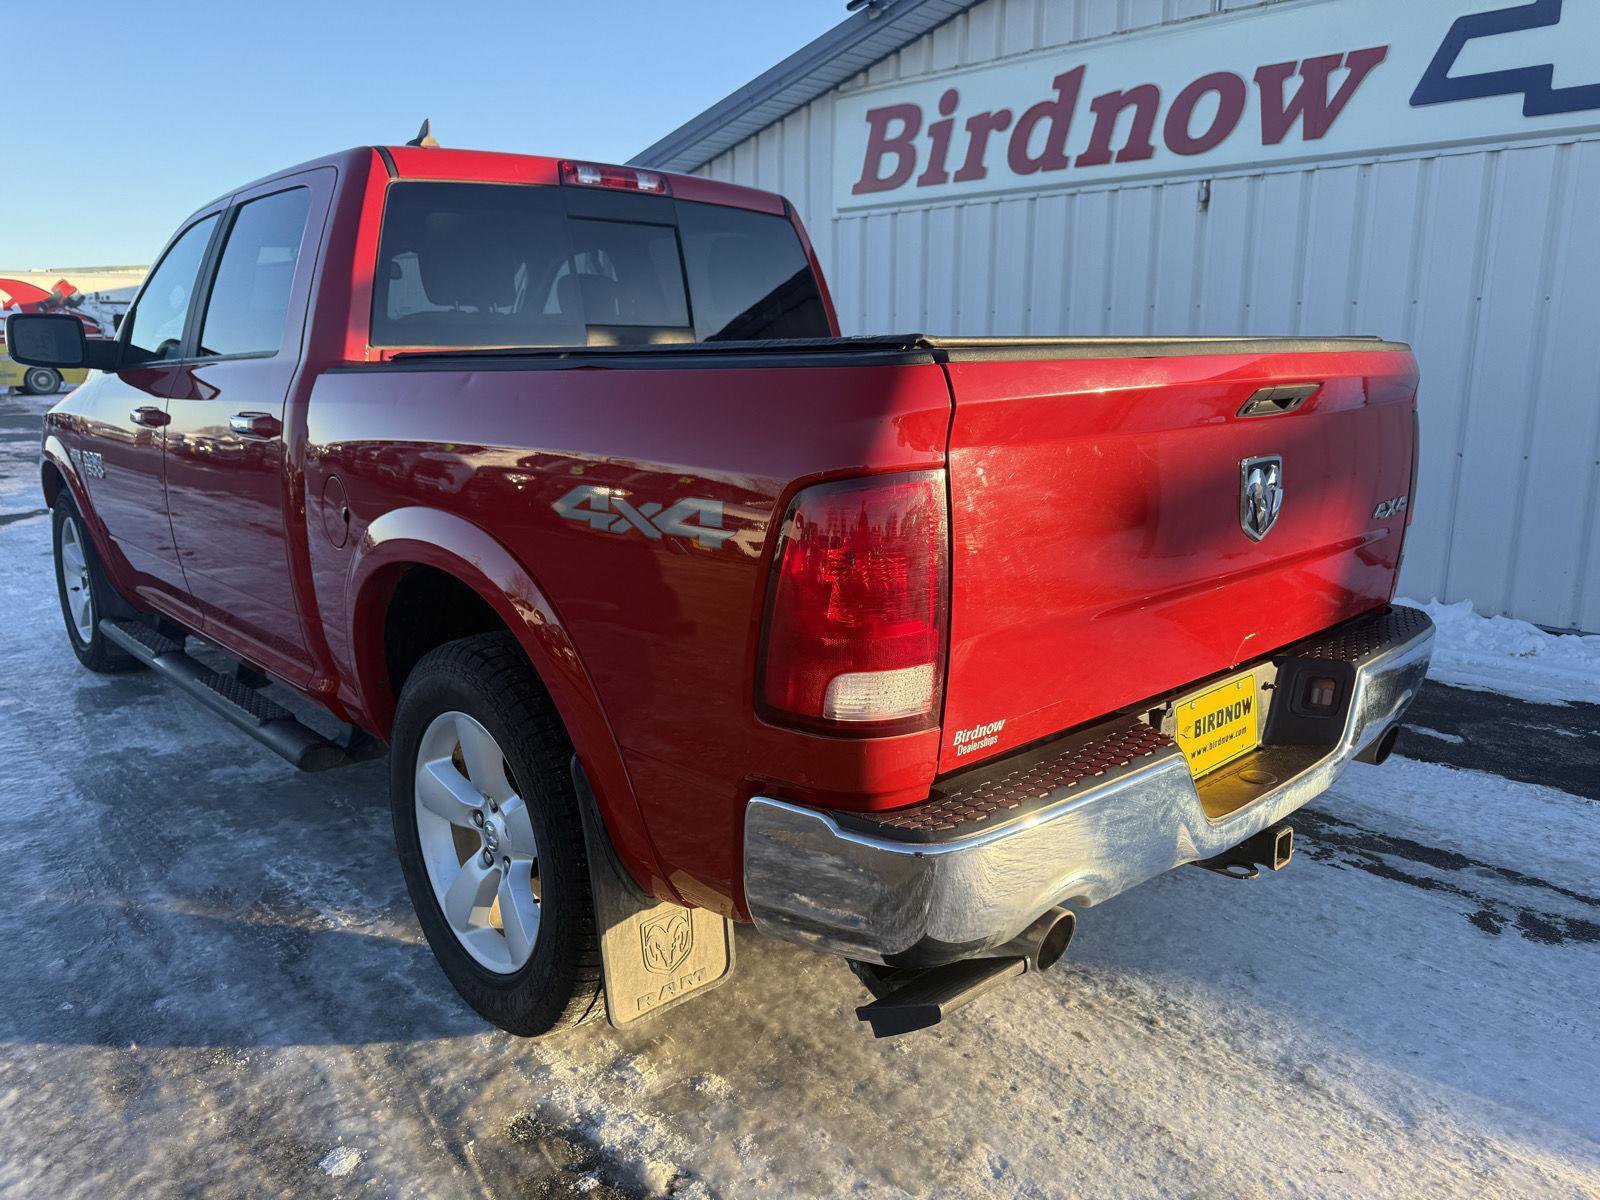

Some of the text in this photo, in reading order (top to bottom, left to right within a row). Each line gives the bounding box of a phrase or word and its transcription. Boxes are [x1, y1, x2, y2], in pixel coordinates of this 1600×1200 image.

[852, 45, 1389, 195] Birdnow
[953, 719, 1006, 746] Birdnow
[1194, 696, 1252, 738] BIRDNOW
[957, 735, 999, 757] Dealerships
[1191, 726, 1247, 759] www.birdnow.com
[637, 967, 706, 1010] RAM
